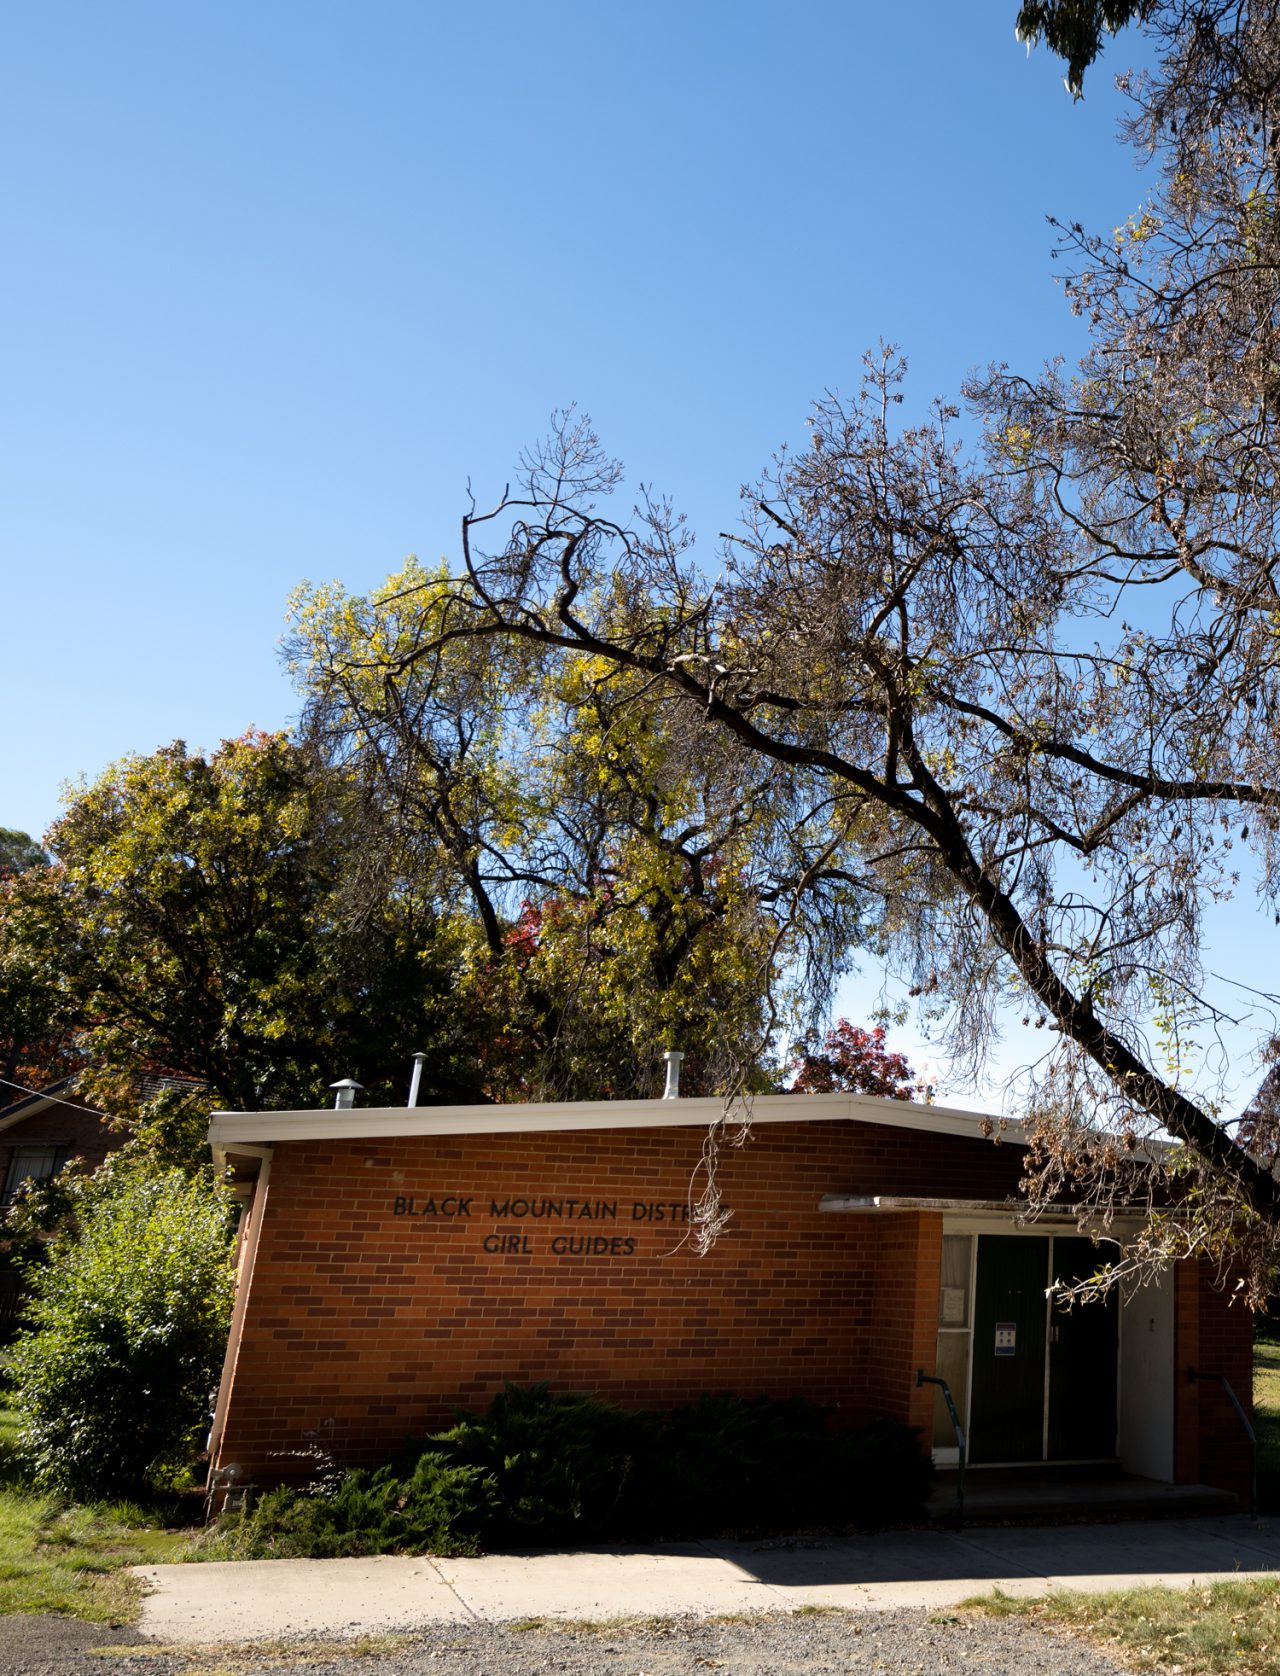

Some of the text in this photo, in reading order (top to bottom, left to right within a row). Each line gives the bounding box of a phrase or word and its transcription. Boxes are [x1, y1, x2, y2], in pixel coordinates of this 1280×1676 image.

[393, 1196, 473, 1216] BLACK
[490, 1199, 618, 1219] MOUNTAIN
[483, 1234, 635, 1255] GIRL GUIDES
